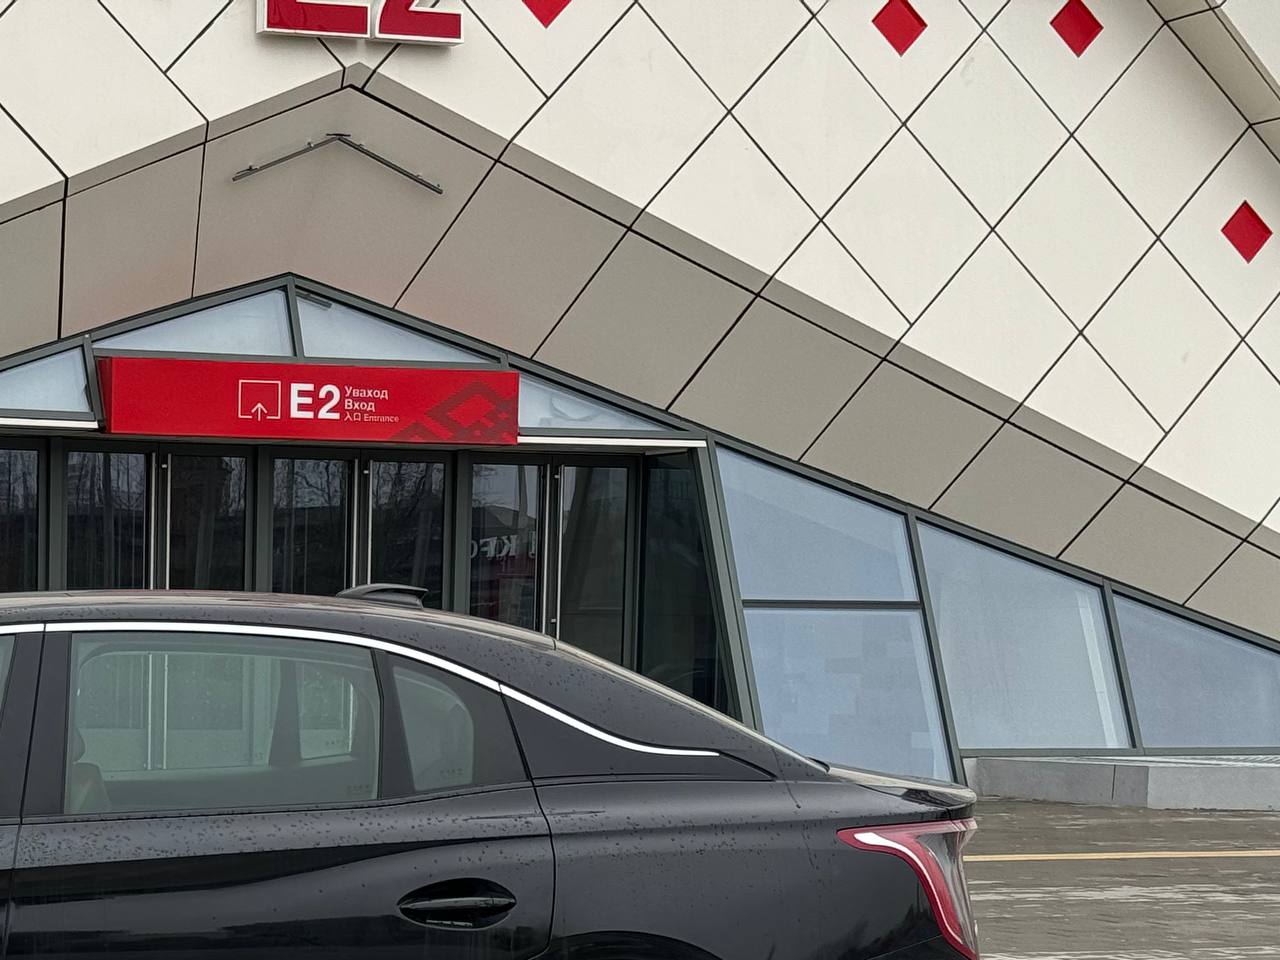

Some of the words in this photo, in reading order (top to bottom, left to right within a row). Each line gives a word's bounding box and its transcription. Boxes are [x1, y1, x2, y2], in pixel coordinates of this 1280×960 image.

[344, 385, 388, 400] Уваход
[290, 383, 340, 419] E2
[344, 399, 375, 412] Вход
[344, 412, 361, 421] 入口
[363, 413, 400, 423] Entrance
